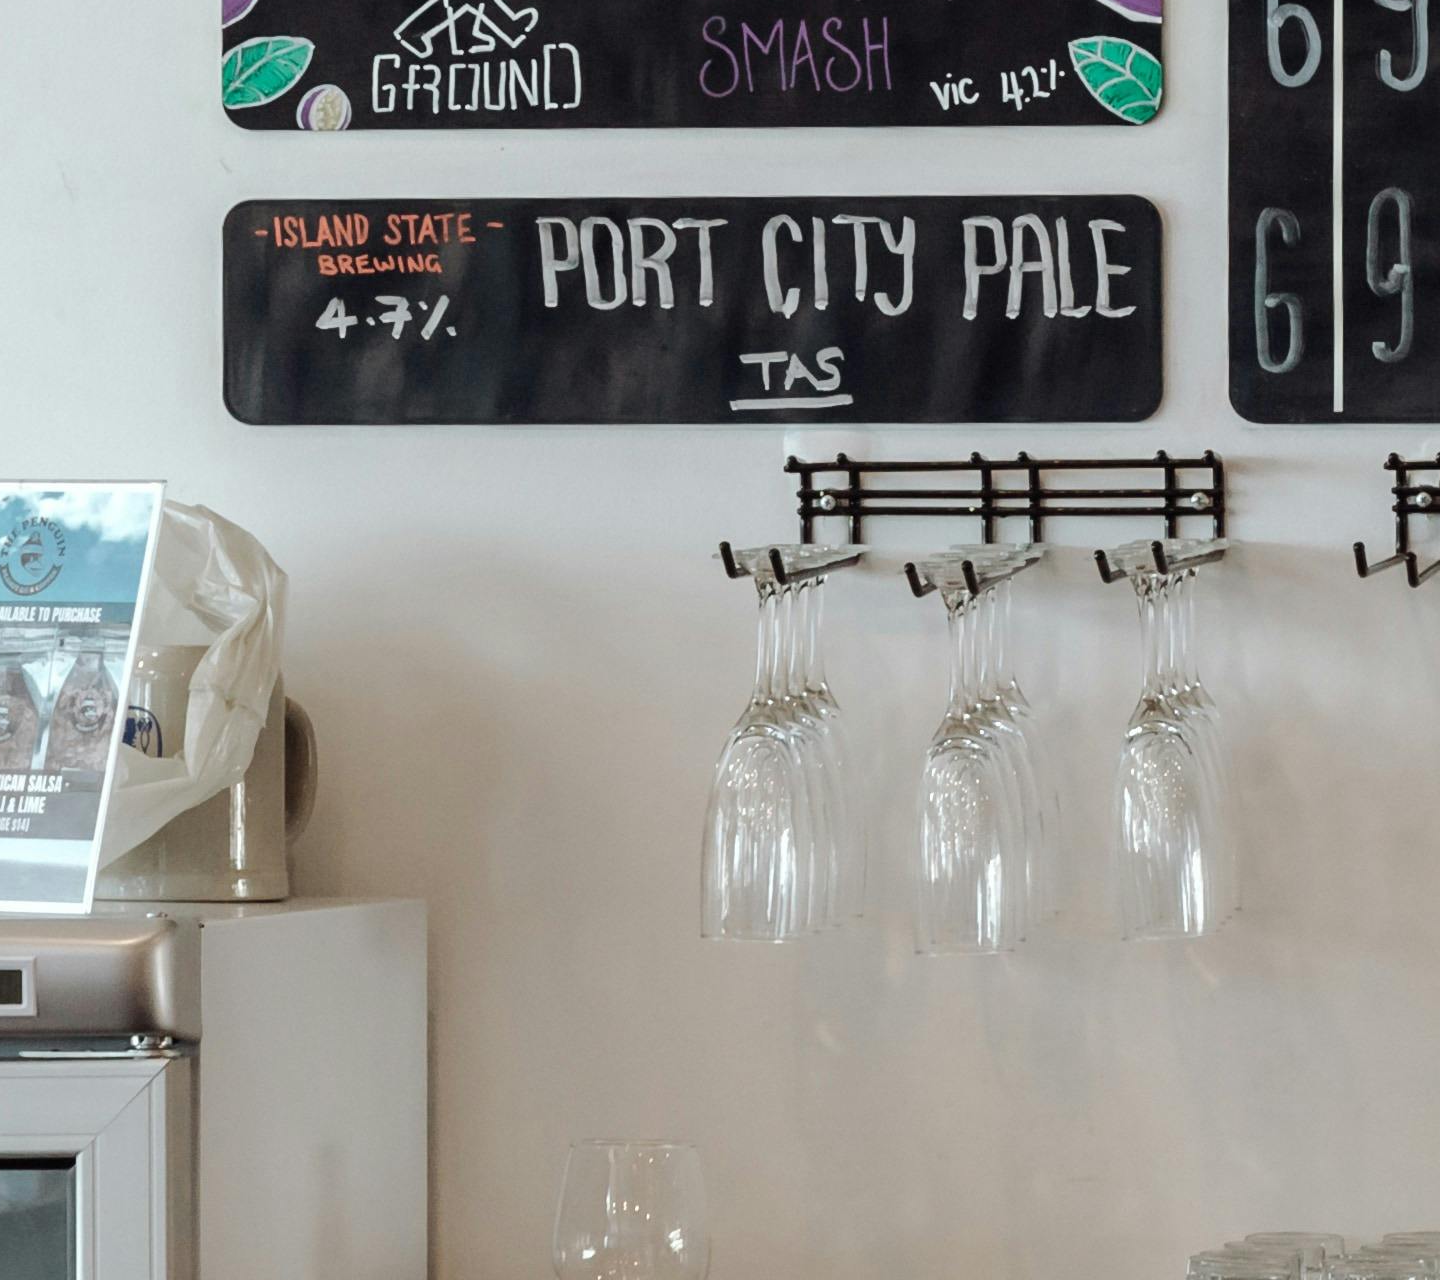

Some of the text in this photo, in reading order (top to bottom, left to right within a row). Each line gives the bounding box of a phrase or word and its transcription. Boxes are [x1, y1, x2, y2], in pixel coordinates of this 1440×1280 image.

[371, 42, 582, 113] GROUND
[697, 16, 894, 99] SMASH
[317, 251, 443, 277] BREWING
[536, 213, 1136, 320] PORT CITY PALE
[741, 348, 844, 392] TAS
[38, 607, 50, 621] TO
[52, 607, 102, 623] PURCHASE
